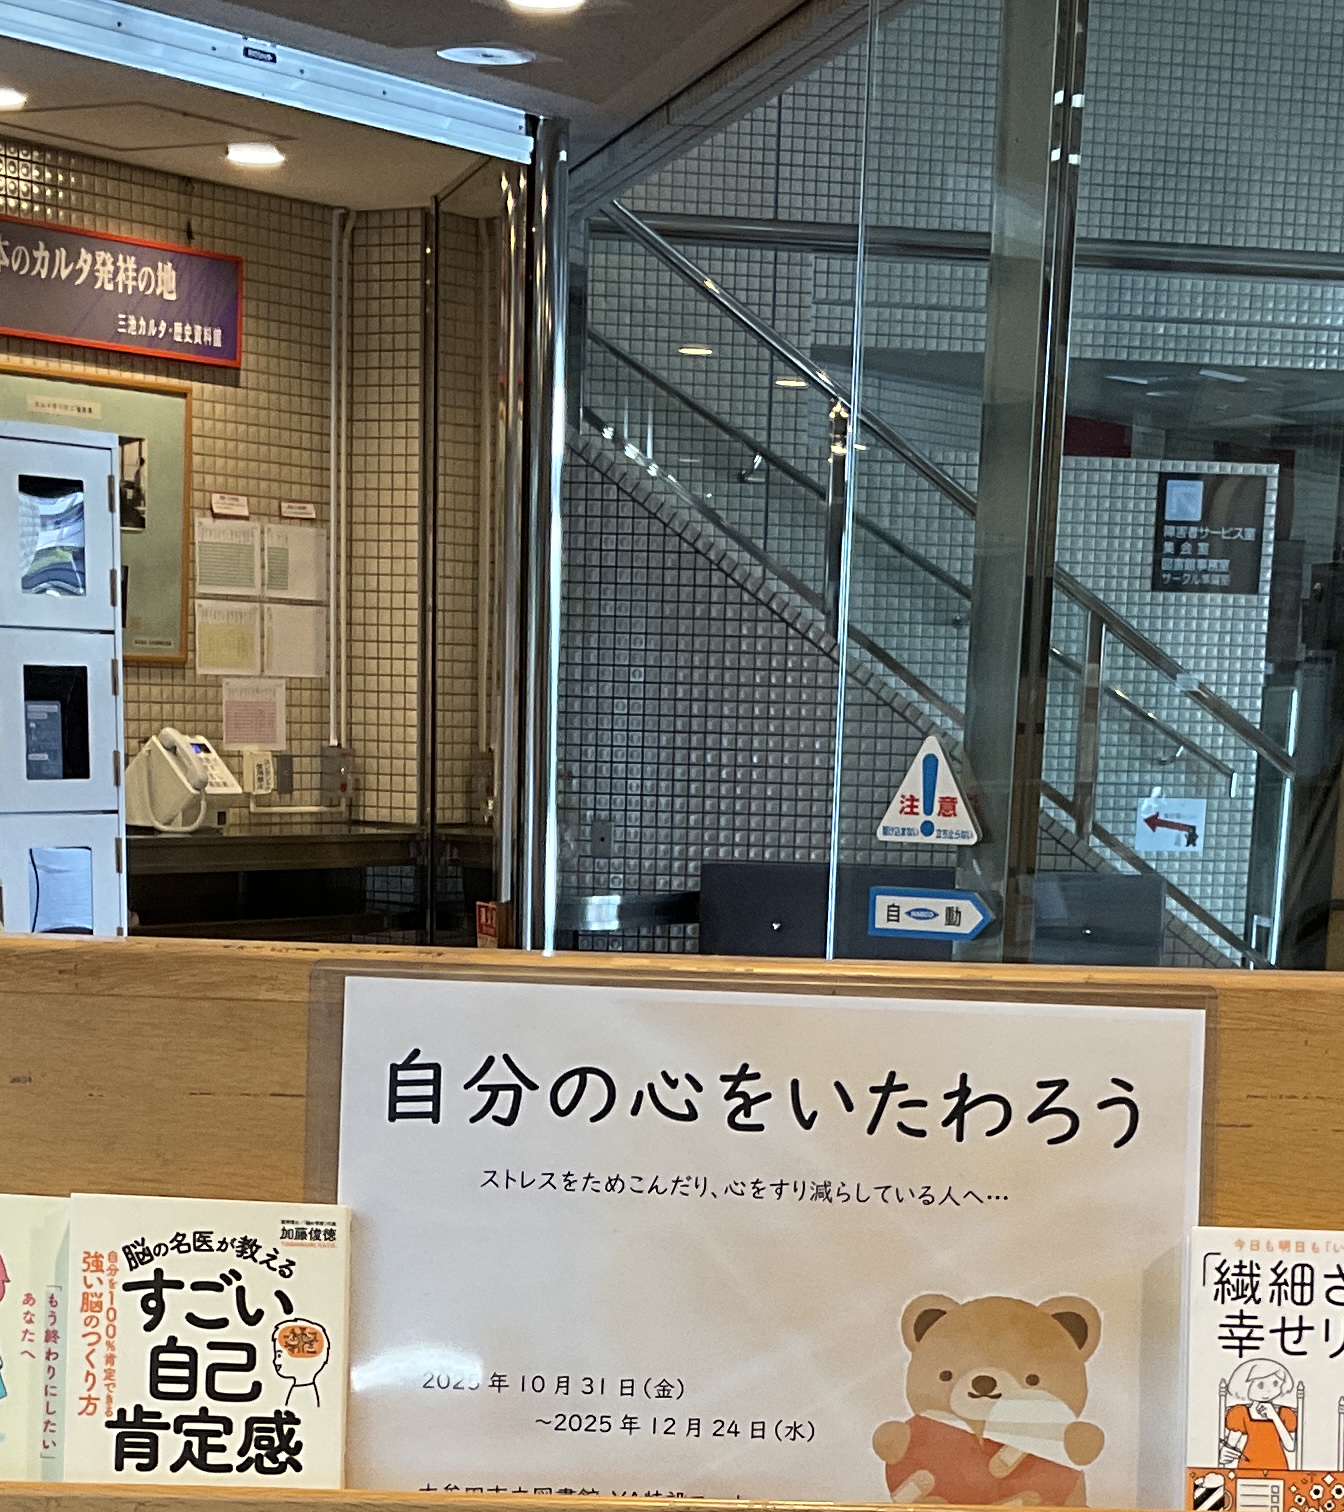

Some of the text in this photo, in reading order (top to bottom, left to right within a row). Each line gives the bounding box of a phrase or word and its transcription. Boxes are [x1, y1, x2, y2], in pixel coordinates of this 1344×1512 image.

[385, 1046, 1141, 1149] 自分の心をいたわろう
[121, 1229, 297, 1280] 脳の名医が教える
[19, 1292, 37, 1360] あなたへ
[76, 1250, 106, 1417] 強い脳のつくり方
[121, 1267, 293, 1333] すごい
[40, 1284, 63, 1460] 「もう終わりにしたい」
[149, 1336, 262, 1403] 自己
[105, 1404, 304, 1475] 肯定感
